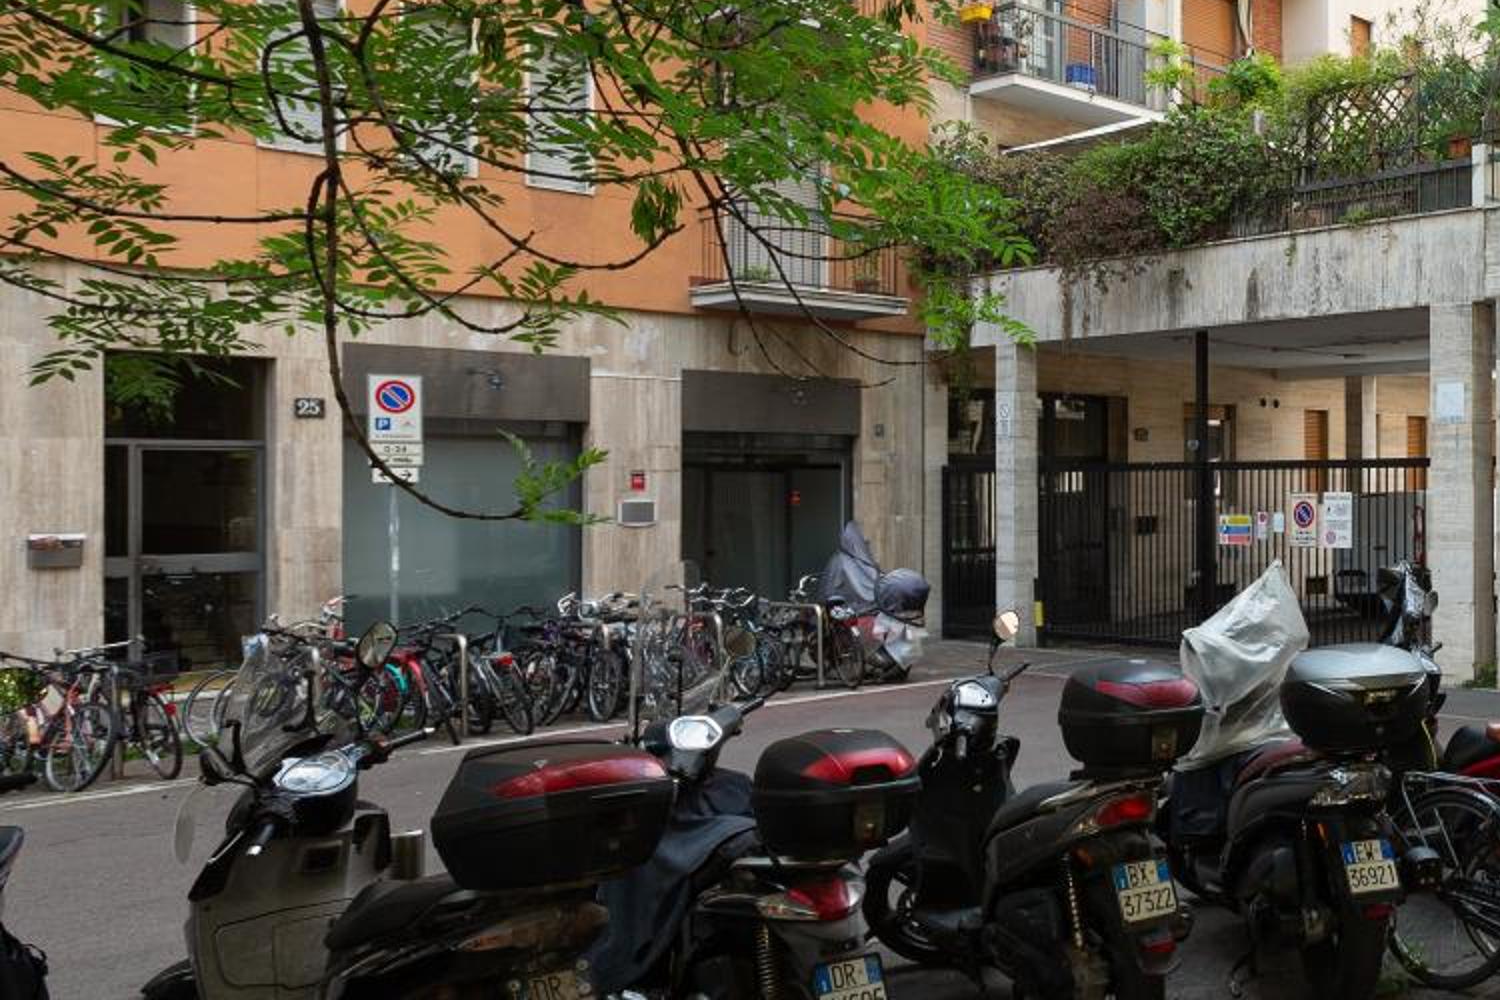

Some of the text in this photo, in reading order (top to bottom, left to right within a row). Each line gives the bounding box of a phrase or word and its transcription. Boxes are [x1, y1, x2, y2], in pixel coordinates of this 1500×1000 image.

[296, 399, 321, 416] 25
[1355, 842, 1376, 863] EW
[1349, 864, 1395, 888] 36921
[1123, 887, 1175, 917] 37322
[831, 963, 857, 989] DR
